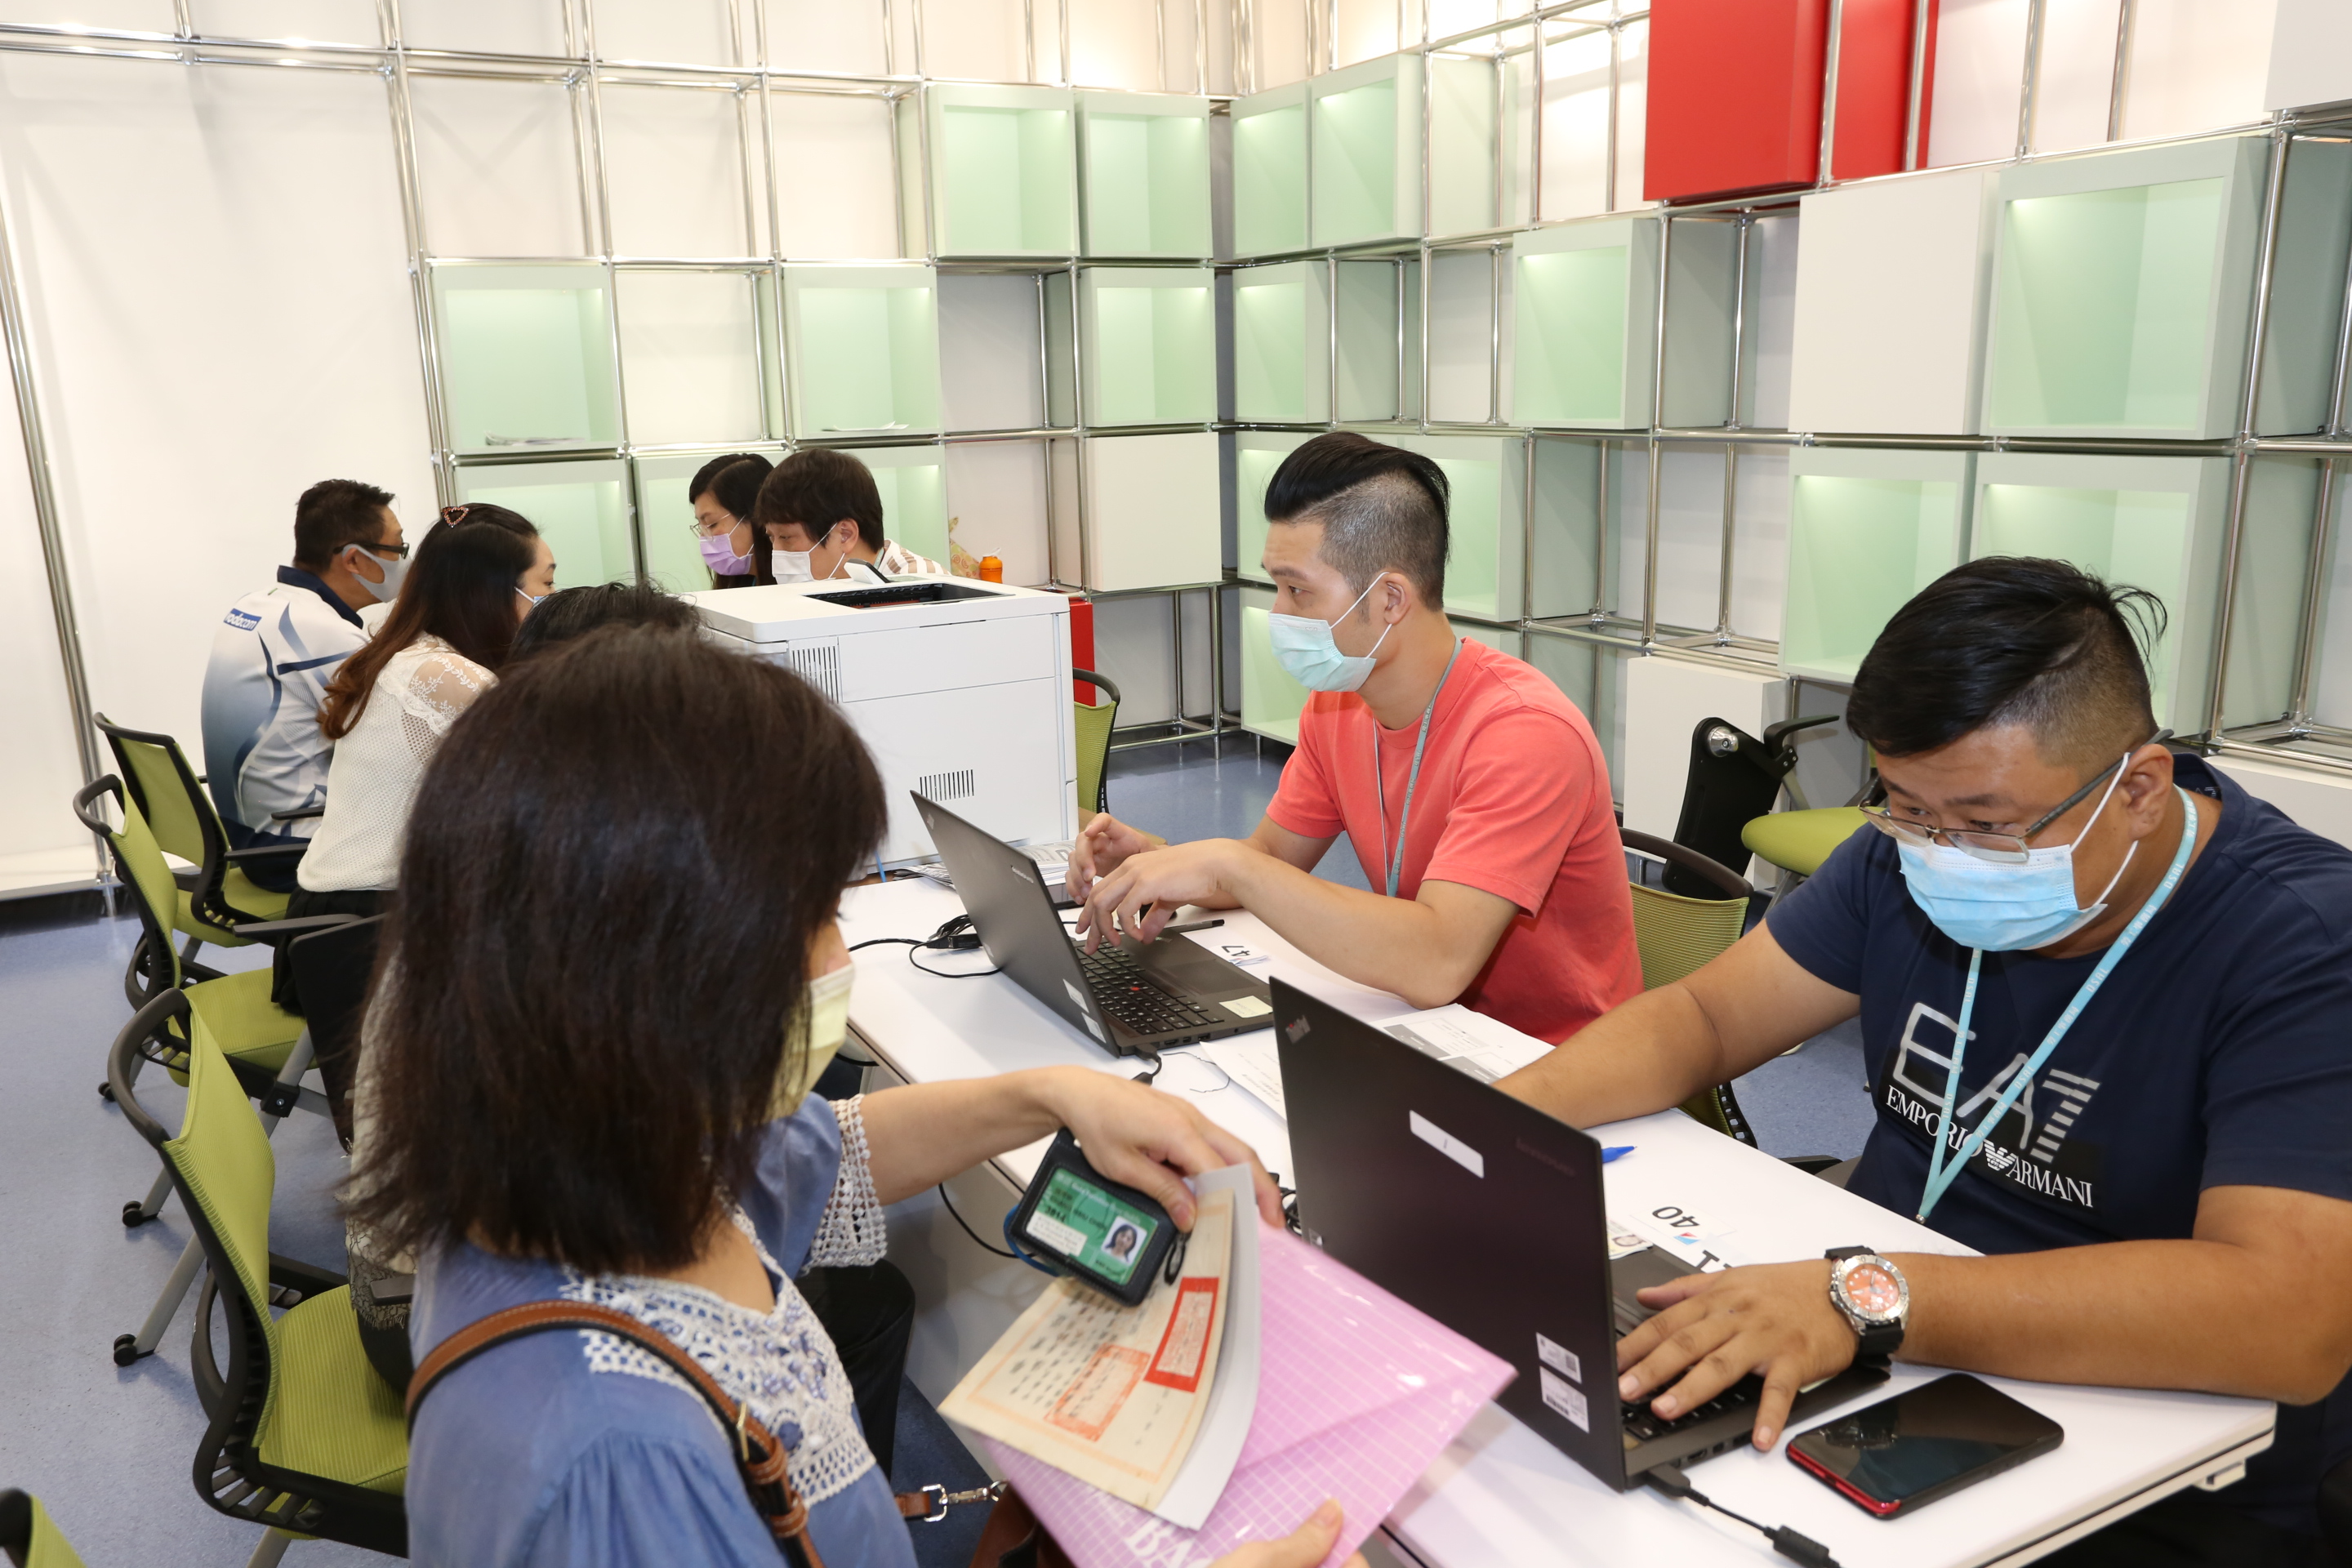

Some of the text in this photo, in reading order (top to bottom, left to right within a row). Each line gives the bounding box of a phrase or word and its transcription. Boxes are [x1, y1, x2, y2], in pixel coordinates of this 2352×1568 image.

[2163, 862, 2185, 889] DSAL
[1221, 945, 1250, 956] 47
[2086, 968, 2109, 993] DSAL
[2013, 1065, 2036, 1090] DSAL
[2005, 1155, 2094, 1208] ARMANI
[1651, 1206, 1700, 1227] 40
